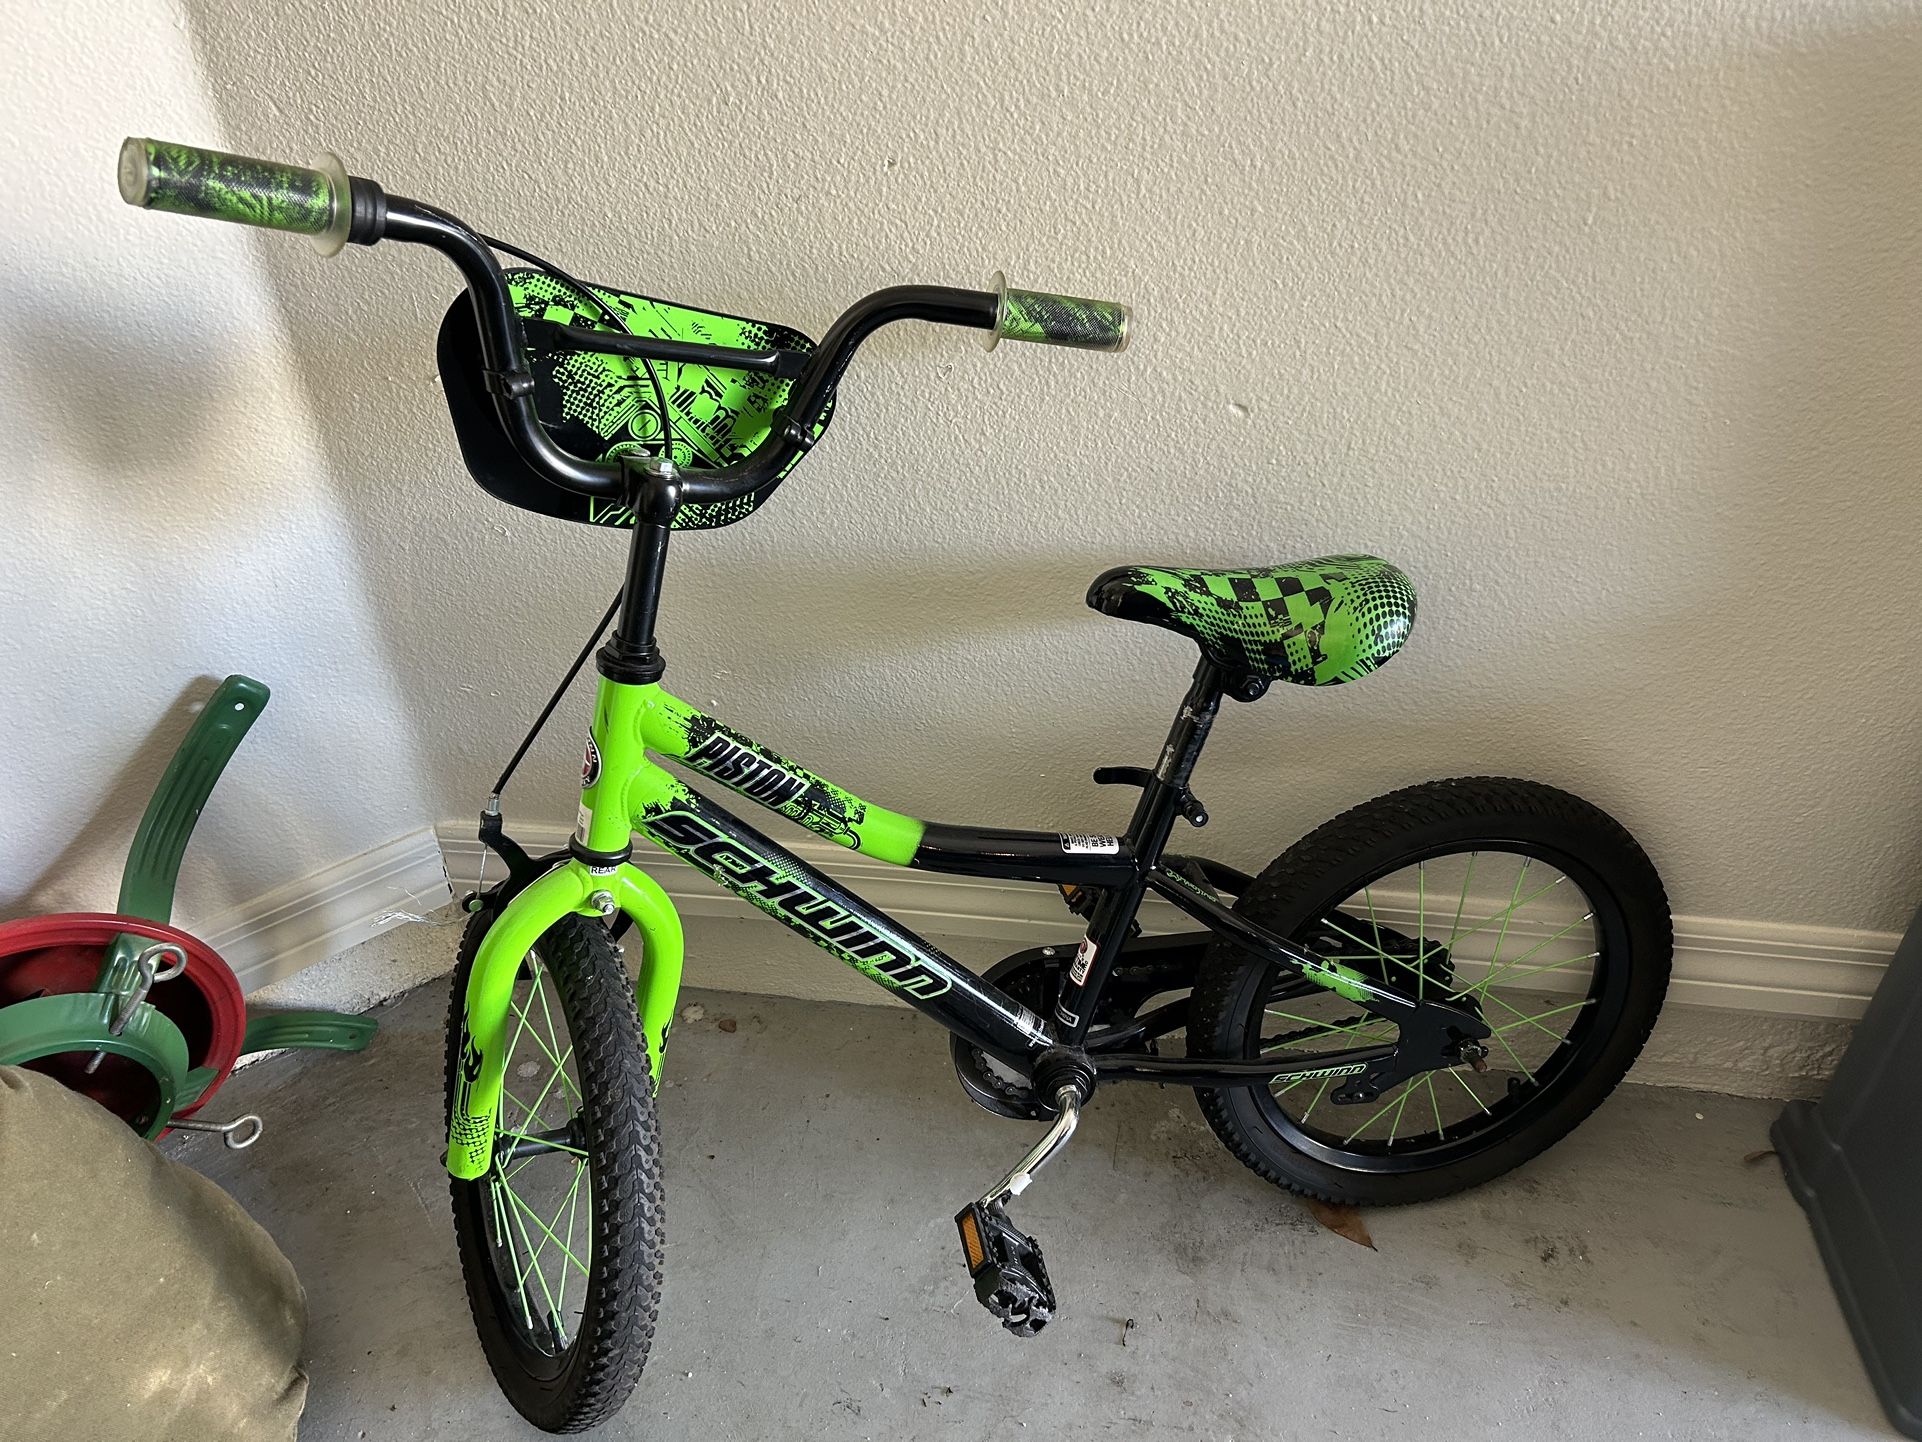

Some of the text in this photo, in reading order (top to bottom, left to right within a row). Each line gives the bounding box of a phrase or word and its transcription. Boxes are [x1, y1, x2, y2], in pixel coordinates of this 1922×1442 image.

[686, 736, 806, 807] PISTON
[643, 811, 952, 999] SCHWINN
[1268, 1064, 1367, 1084] SCHWINN
